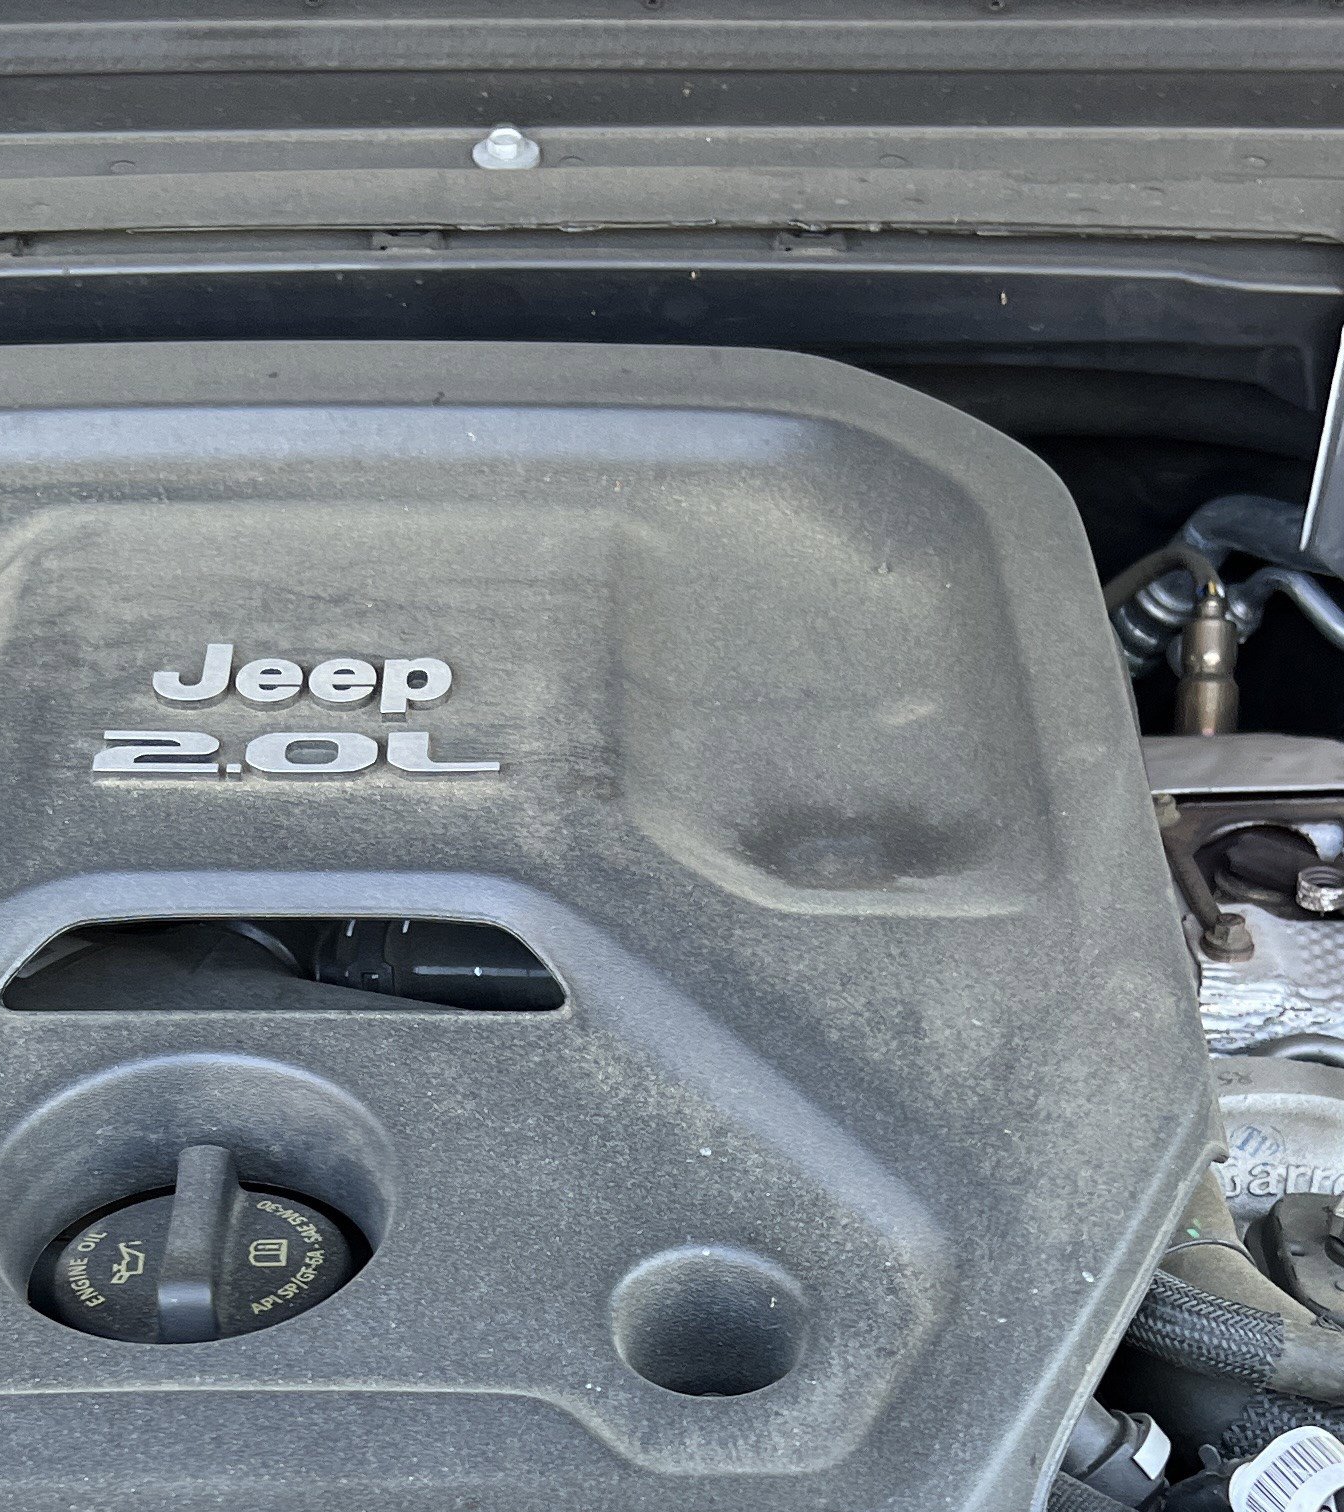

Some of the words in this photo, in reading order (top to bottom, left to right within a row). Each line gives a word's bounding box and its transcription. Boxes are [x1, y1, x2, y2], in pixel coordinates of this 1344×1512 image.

[152, 643, 454, 715] Jeep
[92, 730, 501, 773] 2.0L
[256, 1200, 308, 1226] 5W-30
[77, 1232, 108, 1252] OIL
[297, 1223, 323, 1243] SAE
[67, 1256, 106, 1307] ENGINE
[277, 1249, 325, 1299] SP/GF-6A
[251, 1294, 284, 1315] API
